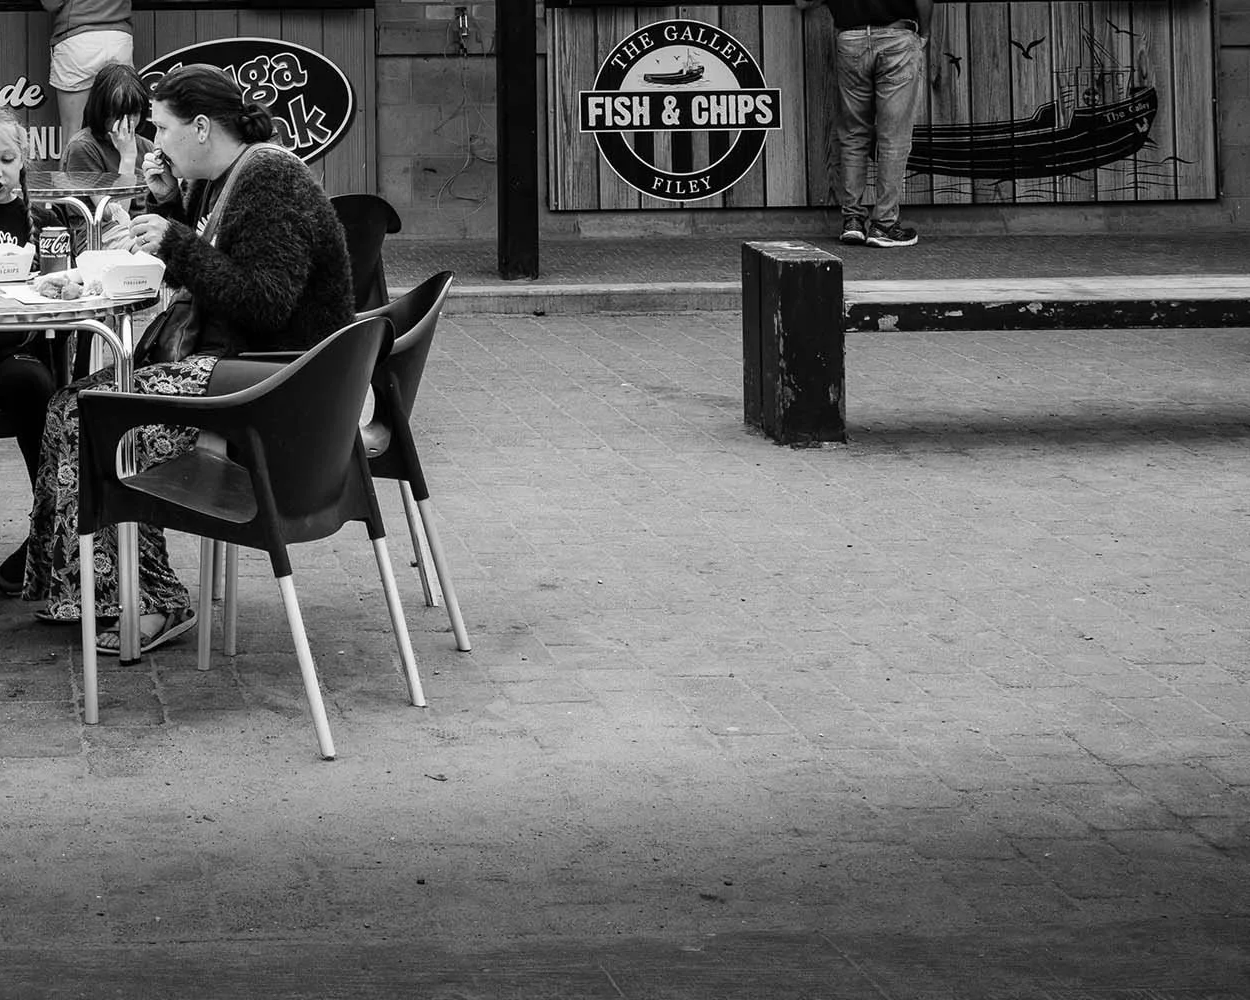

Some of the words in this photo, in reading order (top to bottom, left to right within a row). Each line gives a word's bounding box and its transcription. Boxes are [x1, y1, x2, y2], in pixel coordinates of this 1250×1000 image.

[611, 32, 654, 71] THE
[664, 25, 749, 70] GALLEY
[587, 96, 651, 127] FISH
[661, 95, 681, 126] &
[691, 94, 774, 126] CHIPS
[1103, 111, 1125, 123] The
[651, 175, 712, 195] FILEY
